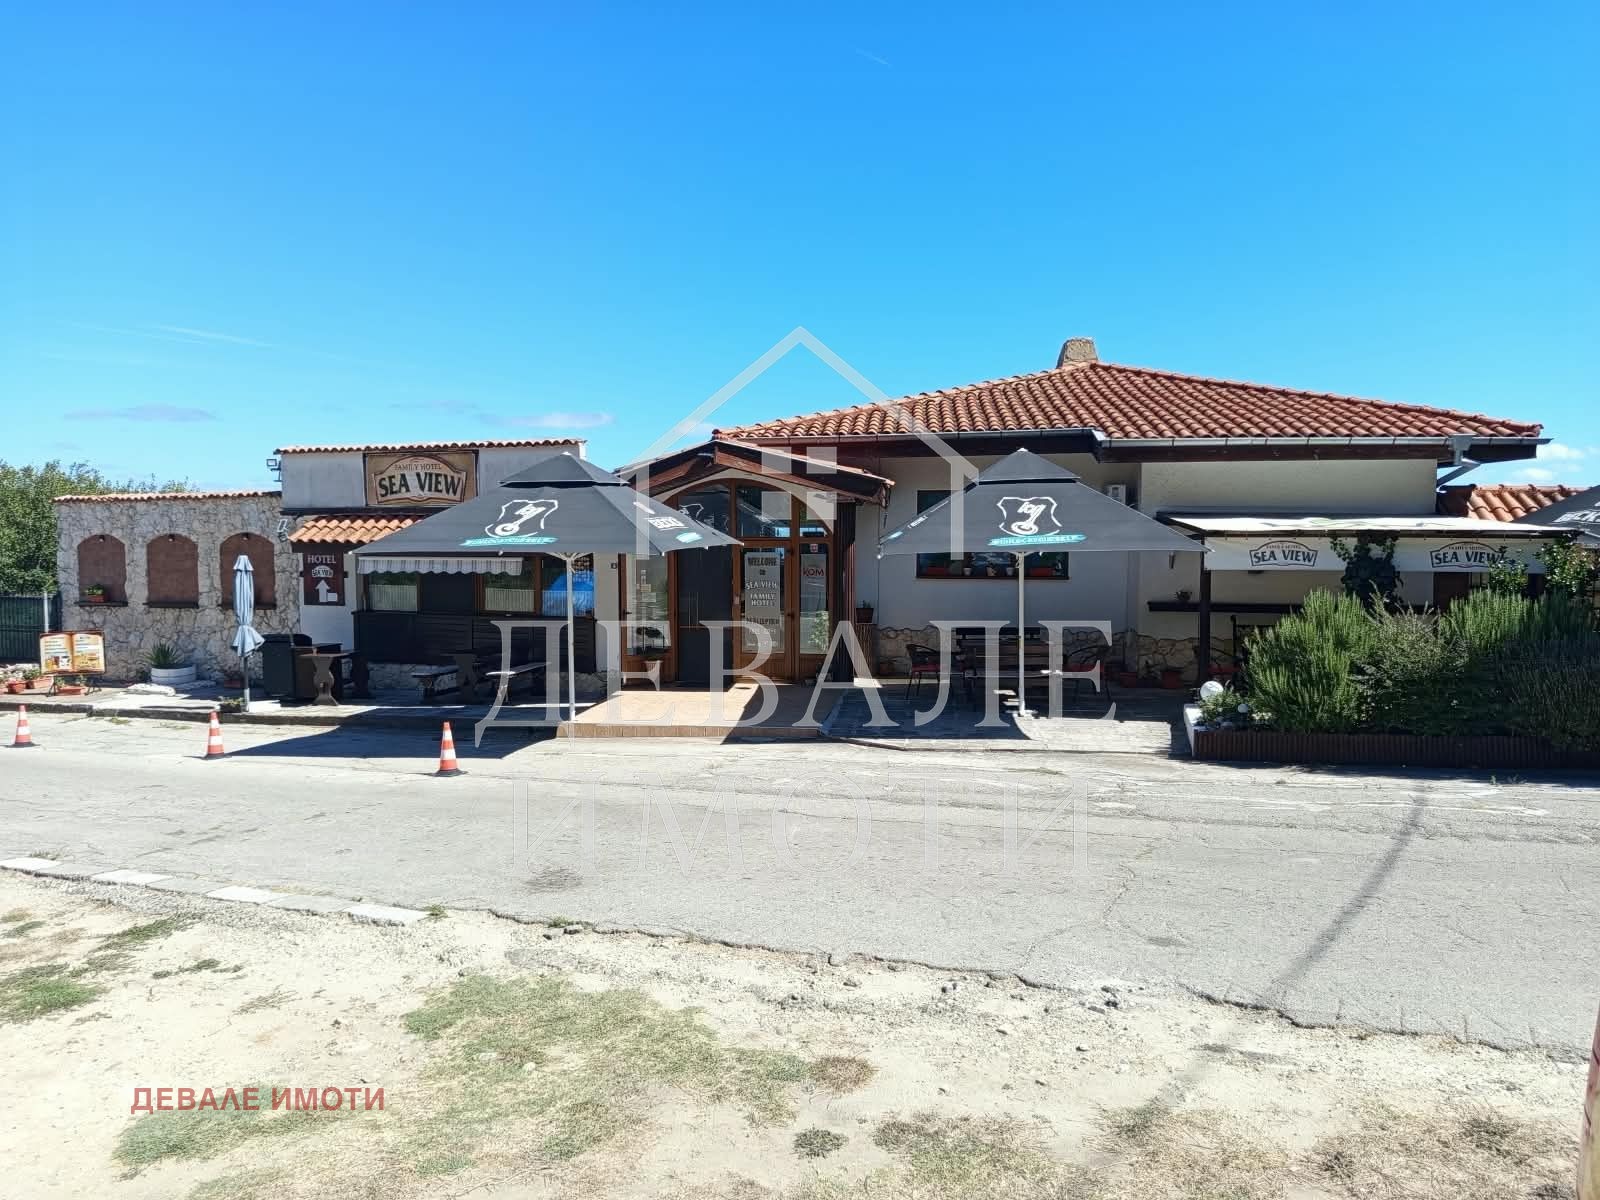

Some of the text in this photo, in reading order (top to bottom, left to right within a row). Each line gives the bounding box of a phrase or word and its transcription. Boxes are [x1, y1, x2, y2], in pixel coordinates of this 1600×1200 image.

[420, 463, 442, 471] HOTEL
[378, 472, 461, 497] SEA VIEW
[307, 555, 337, 563] HOTEL
[1253, 549, 1314, 563] SEA VIEW
[1434, 551, 1500, 564] SEA VIEW
[745, 581, 760, 590] SEA
